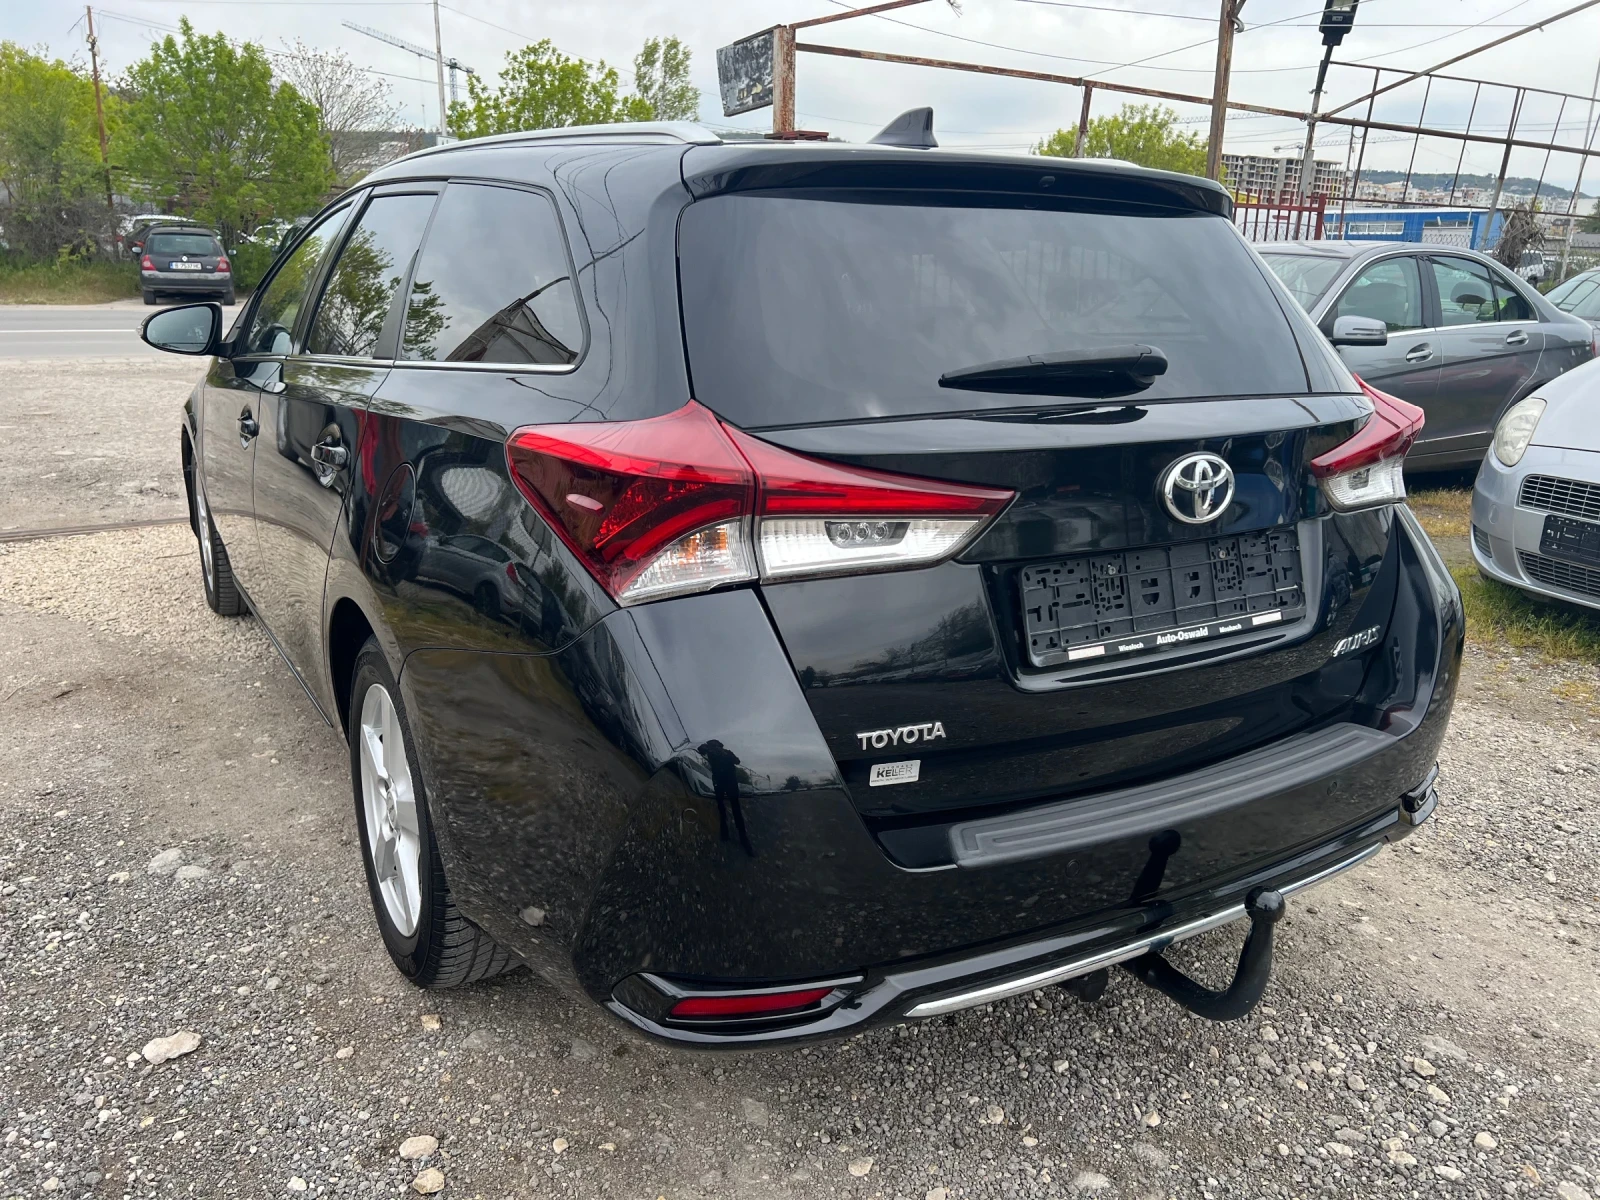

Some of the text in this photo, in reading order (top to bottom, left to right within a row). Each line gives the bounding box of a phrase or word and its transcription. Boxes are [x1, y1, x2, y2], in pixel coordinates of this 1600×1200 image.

[1156, 627, 1208, 645] Auto-Oswald
[856, 721, 946, 751] TOYOTA
[876, 766, 913, 779] KELLER
